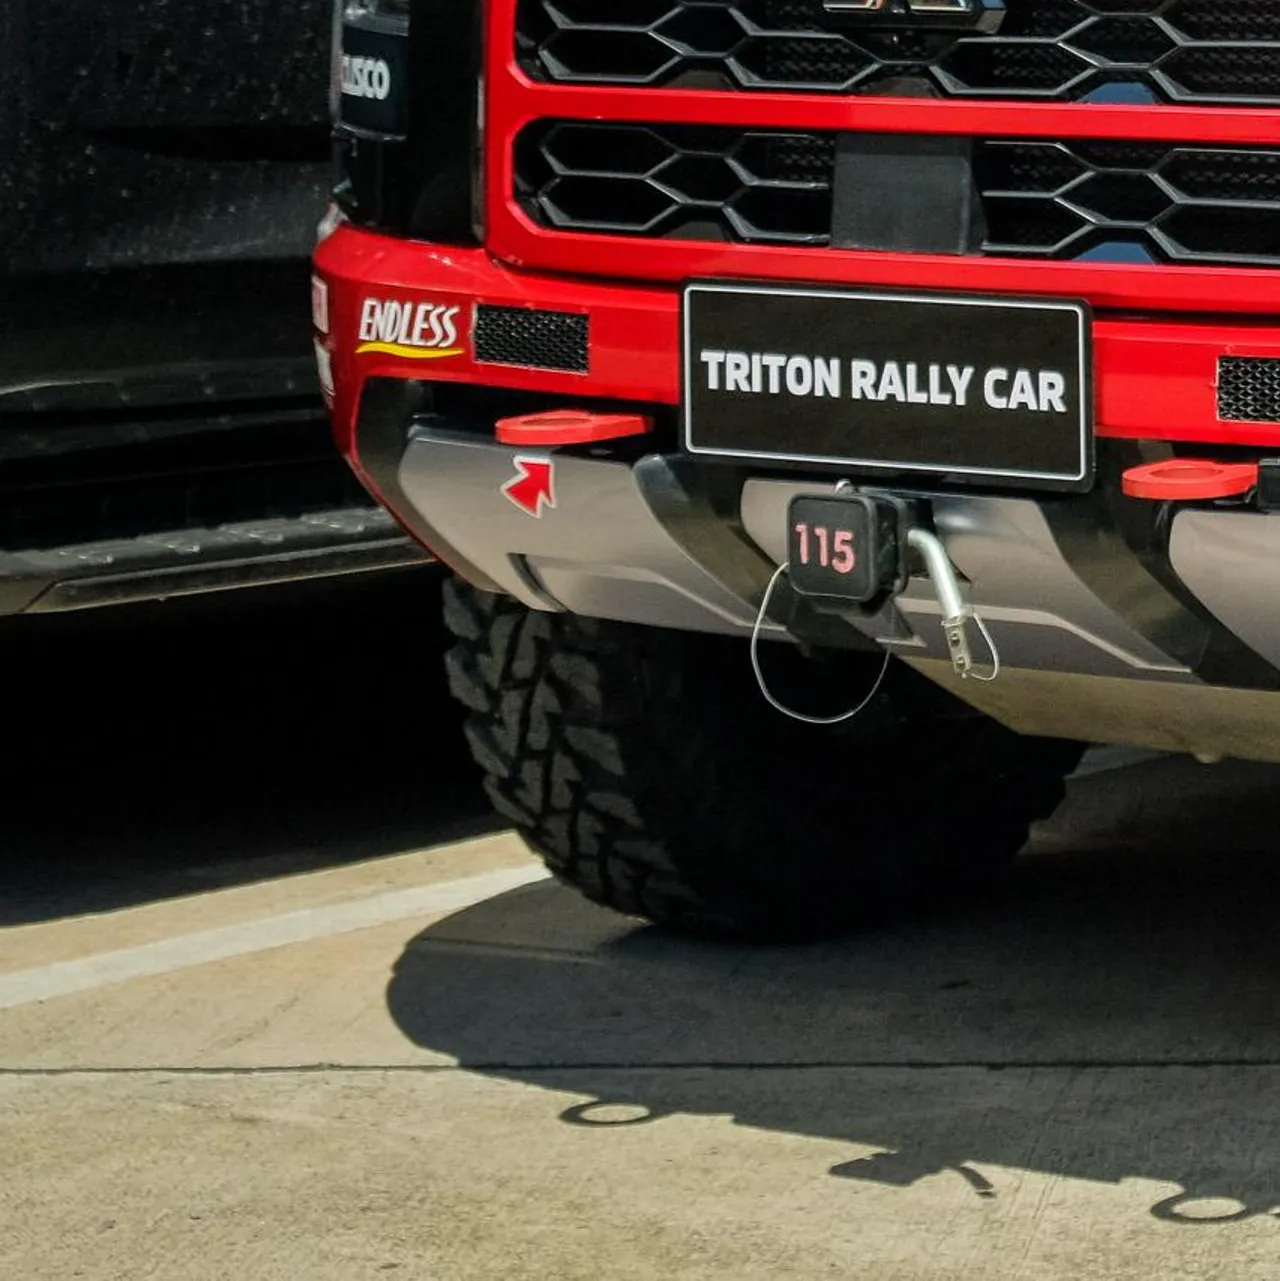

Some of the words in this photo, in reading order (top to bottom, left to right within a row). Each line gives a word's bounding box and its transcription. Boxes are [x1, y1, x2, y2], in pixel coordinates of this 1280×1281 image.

[358, 296, 461, 348] ENDLESS
[701, 349, 842, 398] TRITON
[850, 358, 976, 407] RALLY
[983, 366, 1068, 413] CAR
[794, 521, 857, 575] 115
